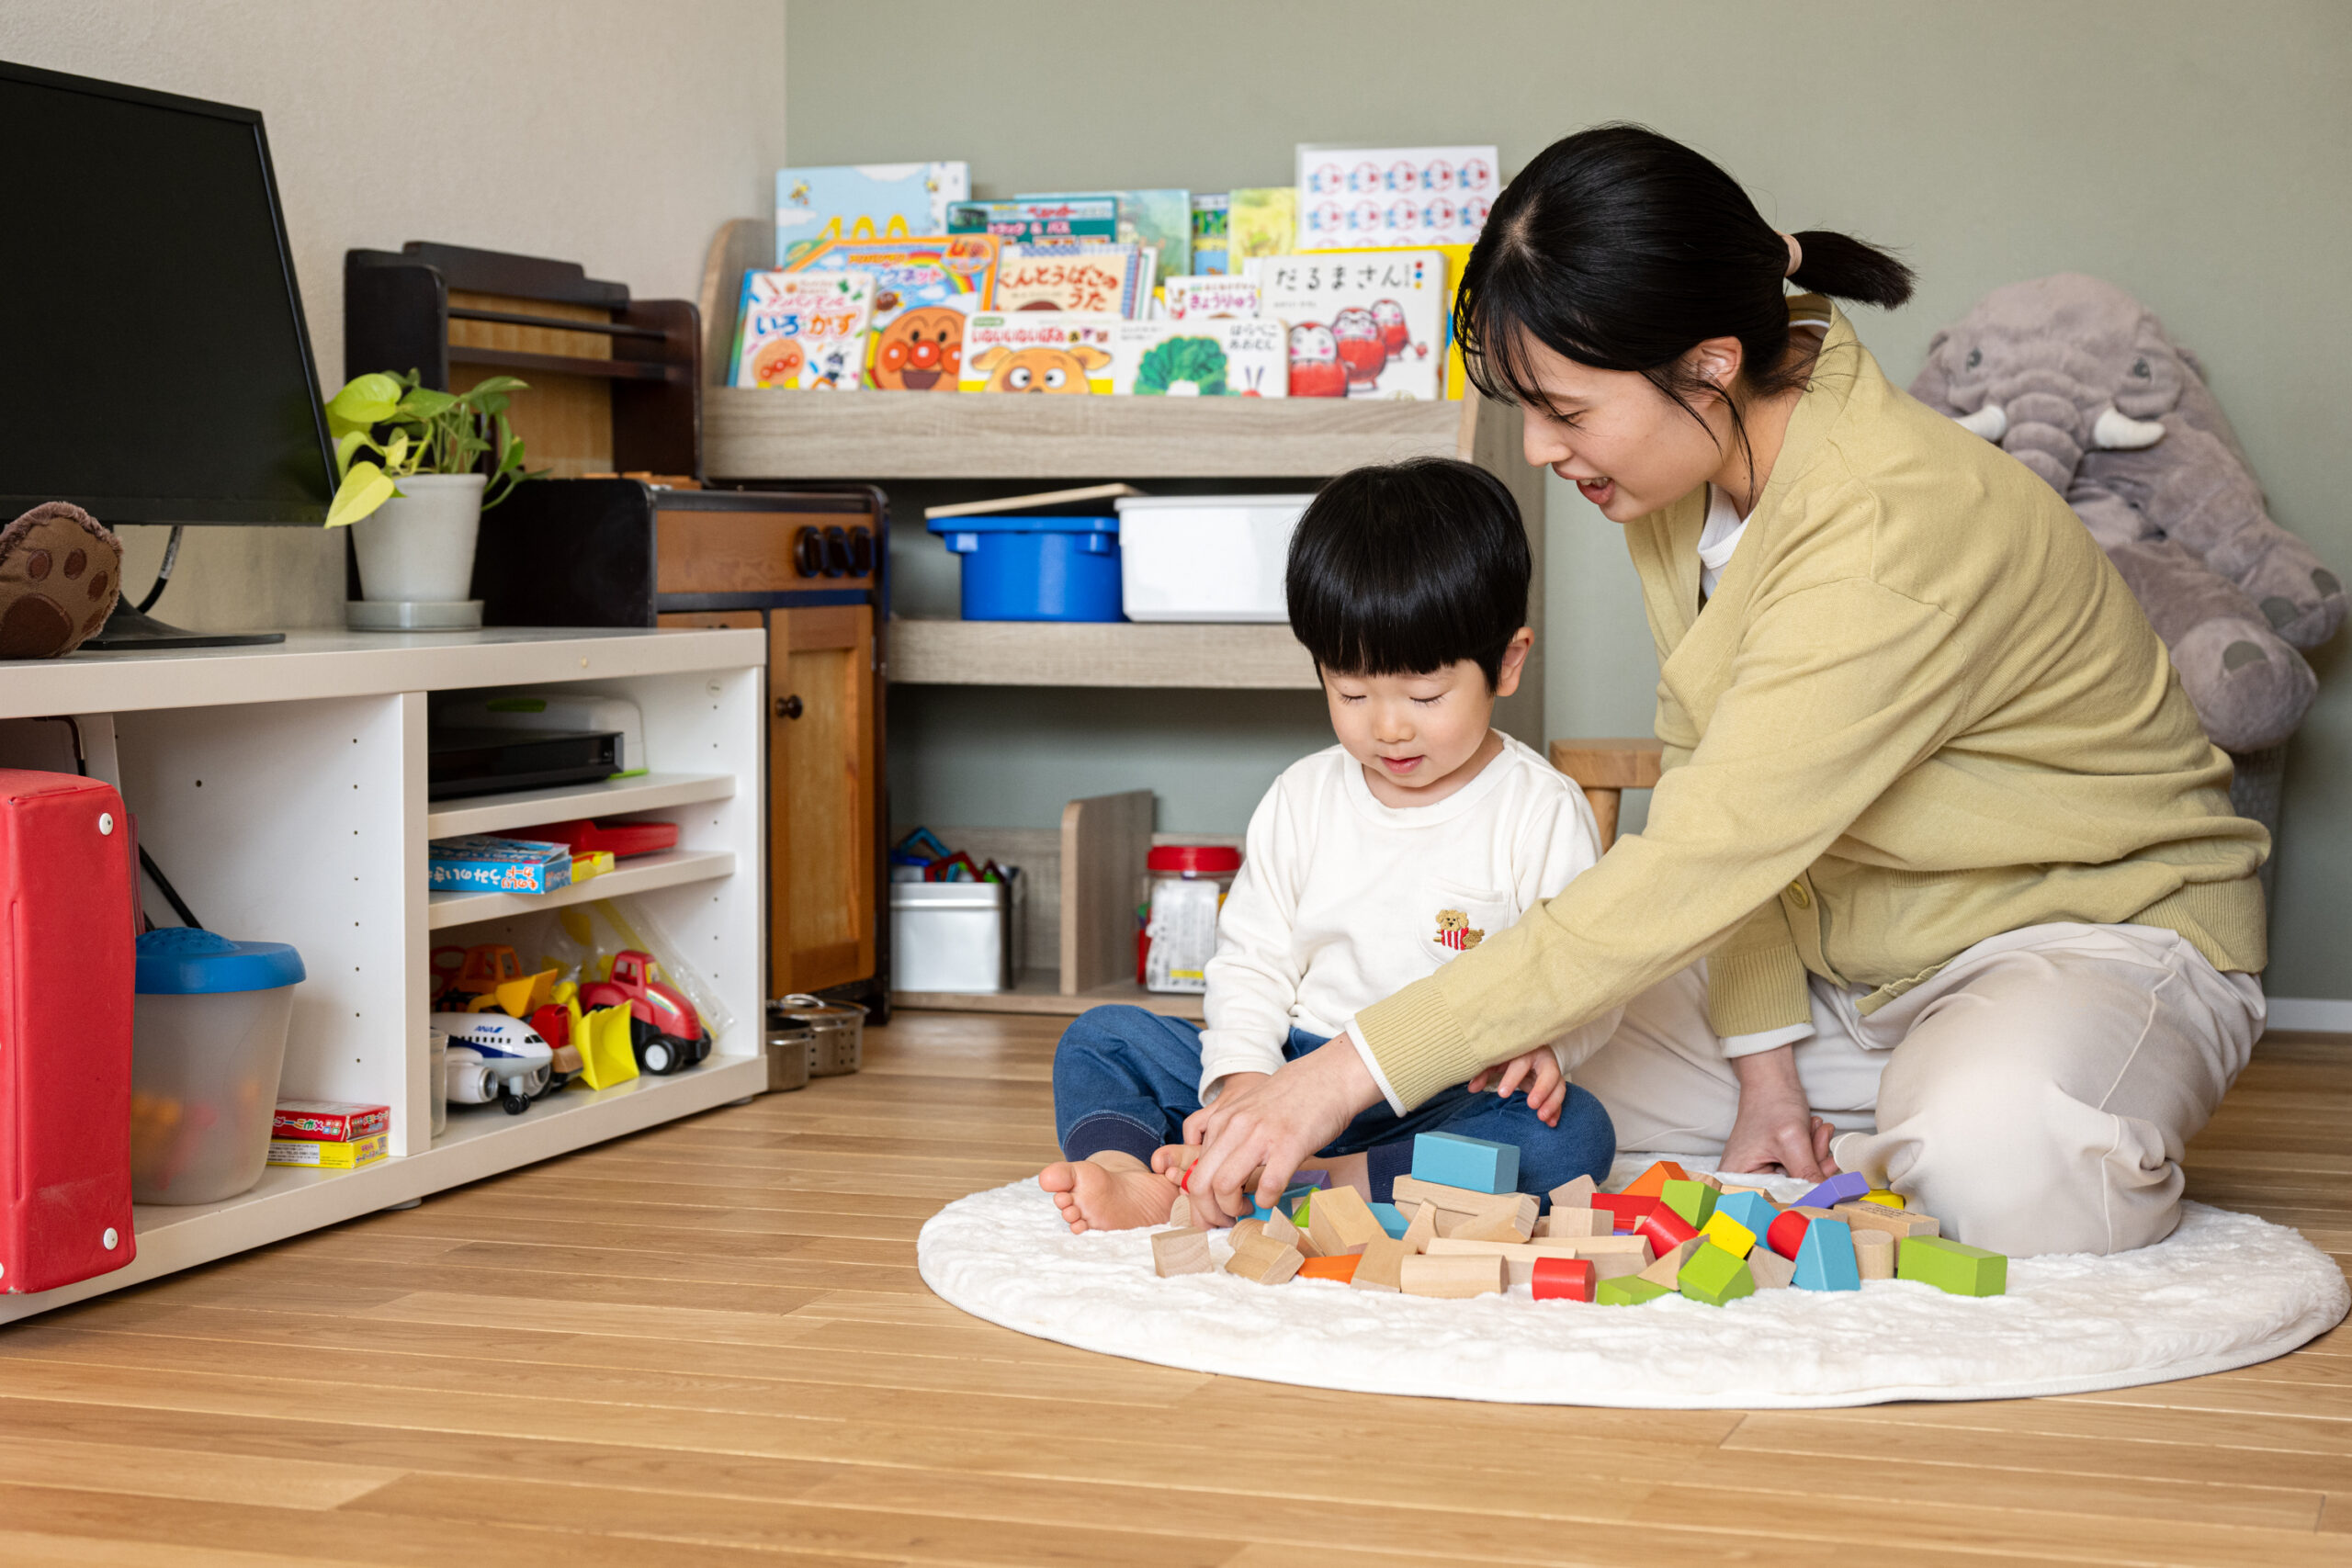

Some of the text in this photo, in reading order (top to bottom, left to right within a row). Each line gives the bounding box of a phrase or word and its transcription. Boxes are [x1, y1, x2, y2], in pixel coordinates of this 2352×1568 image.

[1276, 265, 1402, 291] だるまさん
[1068, 287, 1107, 311] うた
[1190, 291, 1257, 310] きょうりゅう
[428, 867, 502, 885] うみのいき
[501, 877, 538, 890] ものしり
